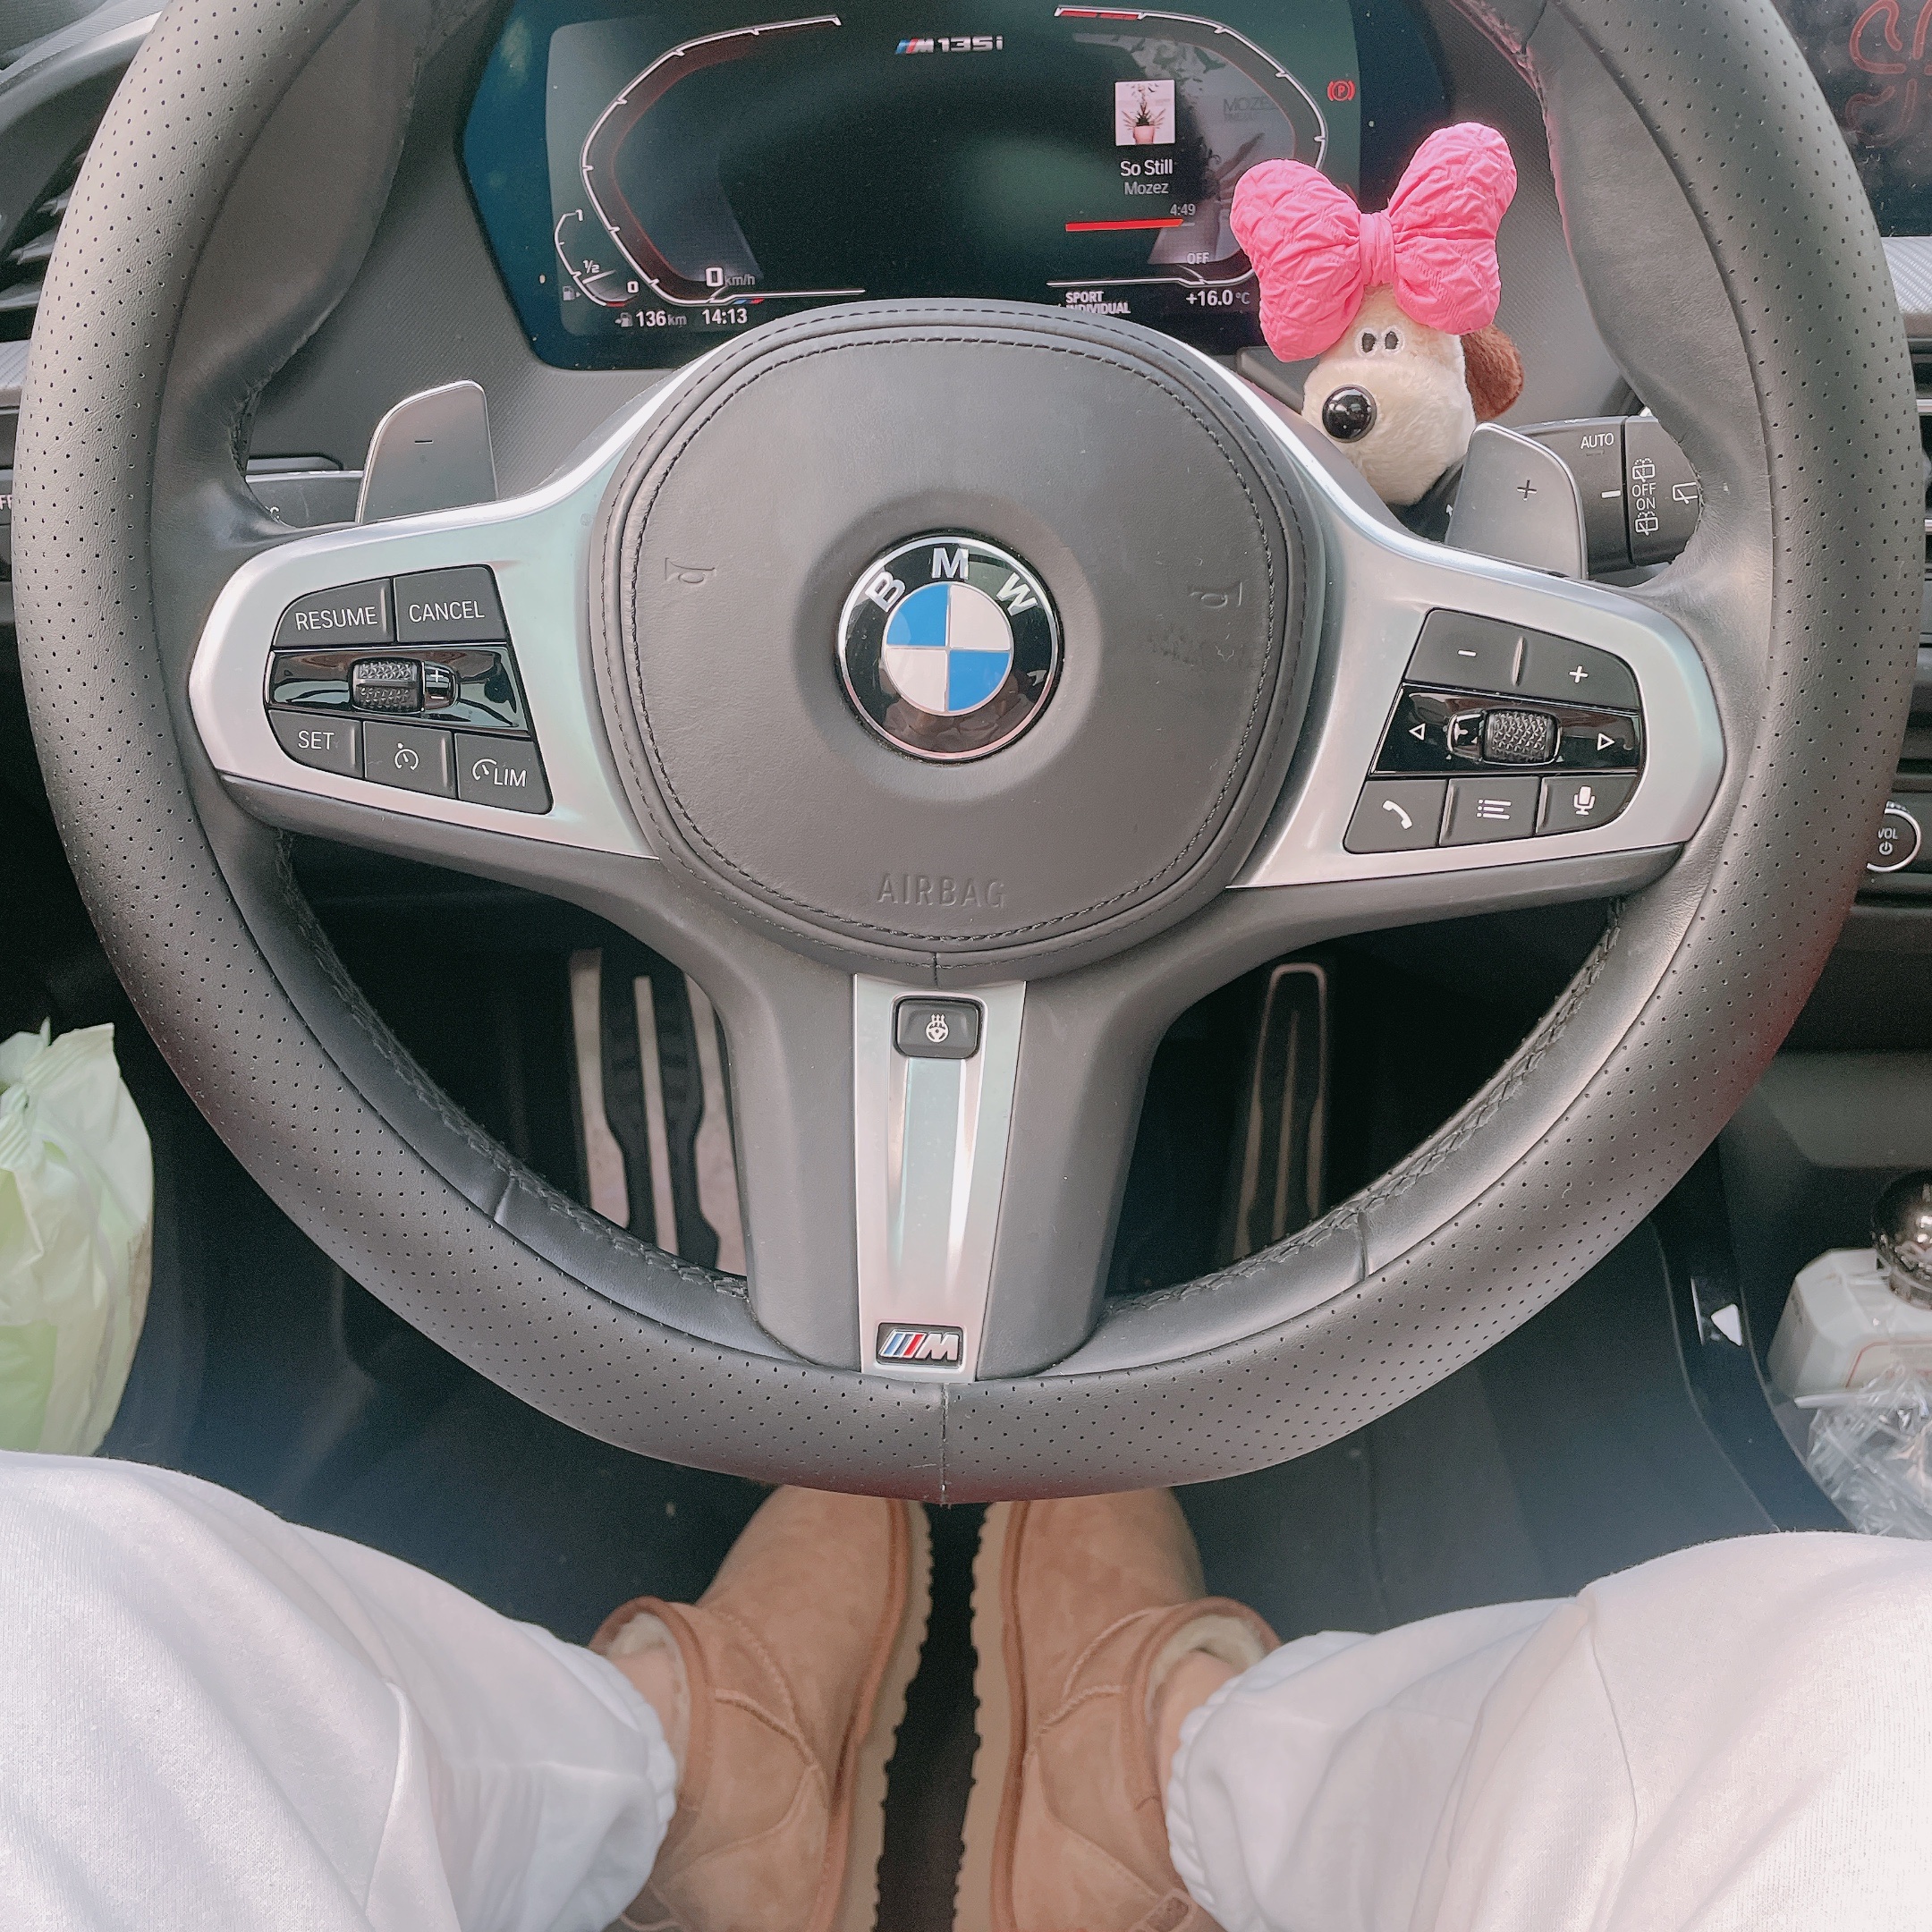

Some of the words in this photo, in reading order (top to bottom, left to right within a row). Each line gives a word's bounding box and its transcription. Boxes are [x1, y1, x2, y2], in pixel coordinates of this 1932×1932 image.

[1120, 160, 1141, 176] So
[1144, 159, 1174, 175] Still
[1123, 181, 1169, 195] Mozez
[1170, 203, 1197, 216] 4:49
[1186, 251, 1210, 265] OFF
[1065, 290, 1105, 303] SPORT
[702, 307, 748, 325] 14:13
[1580, 432, 1614, 449] AUTO
[1631, 483, 1657, 497] OFF
[1636, 497, 1656, 511] ON
[865, 547, 1038, 617] BMW
[294, 606, 378, 631] RESUME
[408, 600, 486, 623] CANCEL
[297, 730, 335, 750] SET
[493, 767, 528, 788] LIM
[1877, 827, 1899, 840] VOL
[877, 872, 1005, 909] AIRBAG
